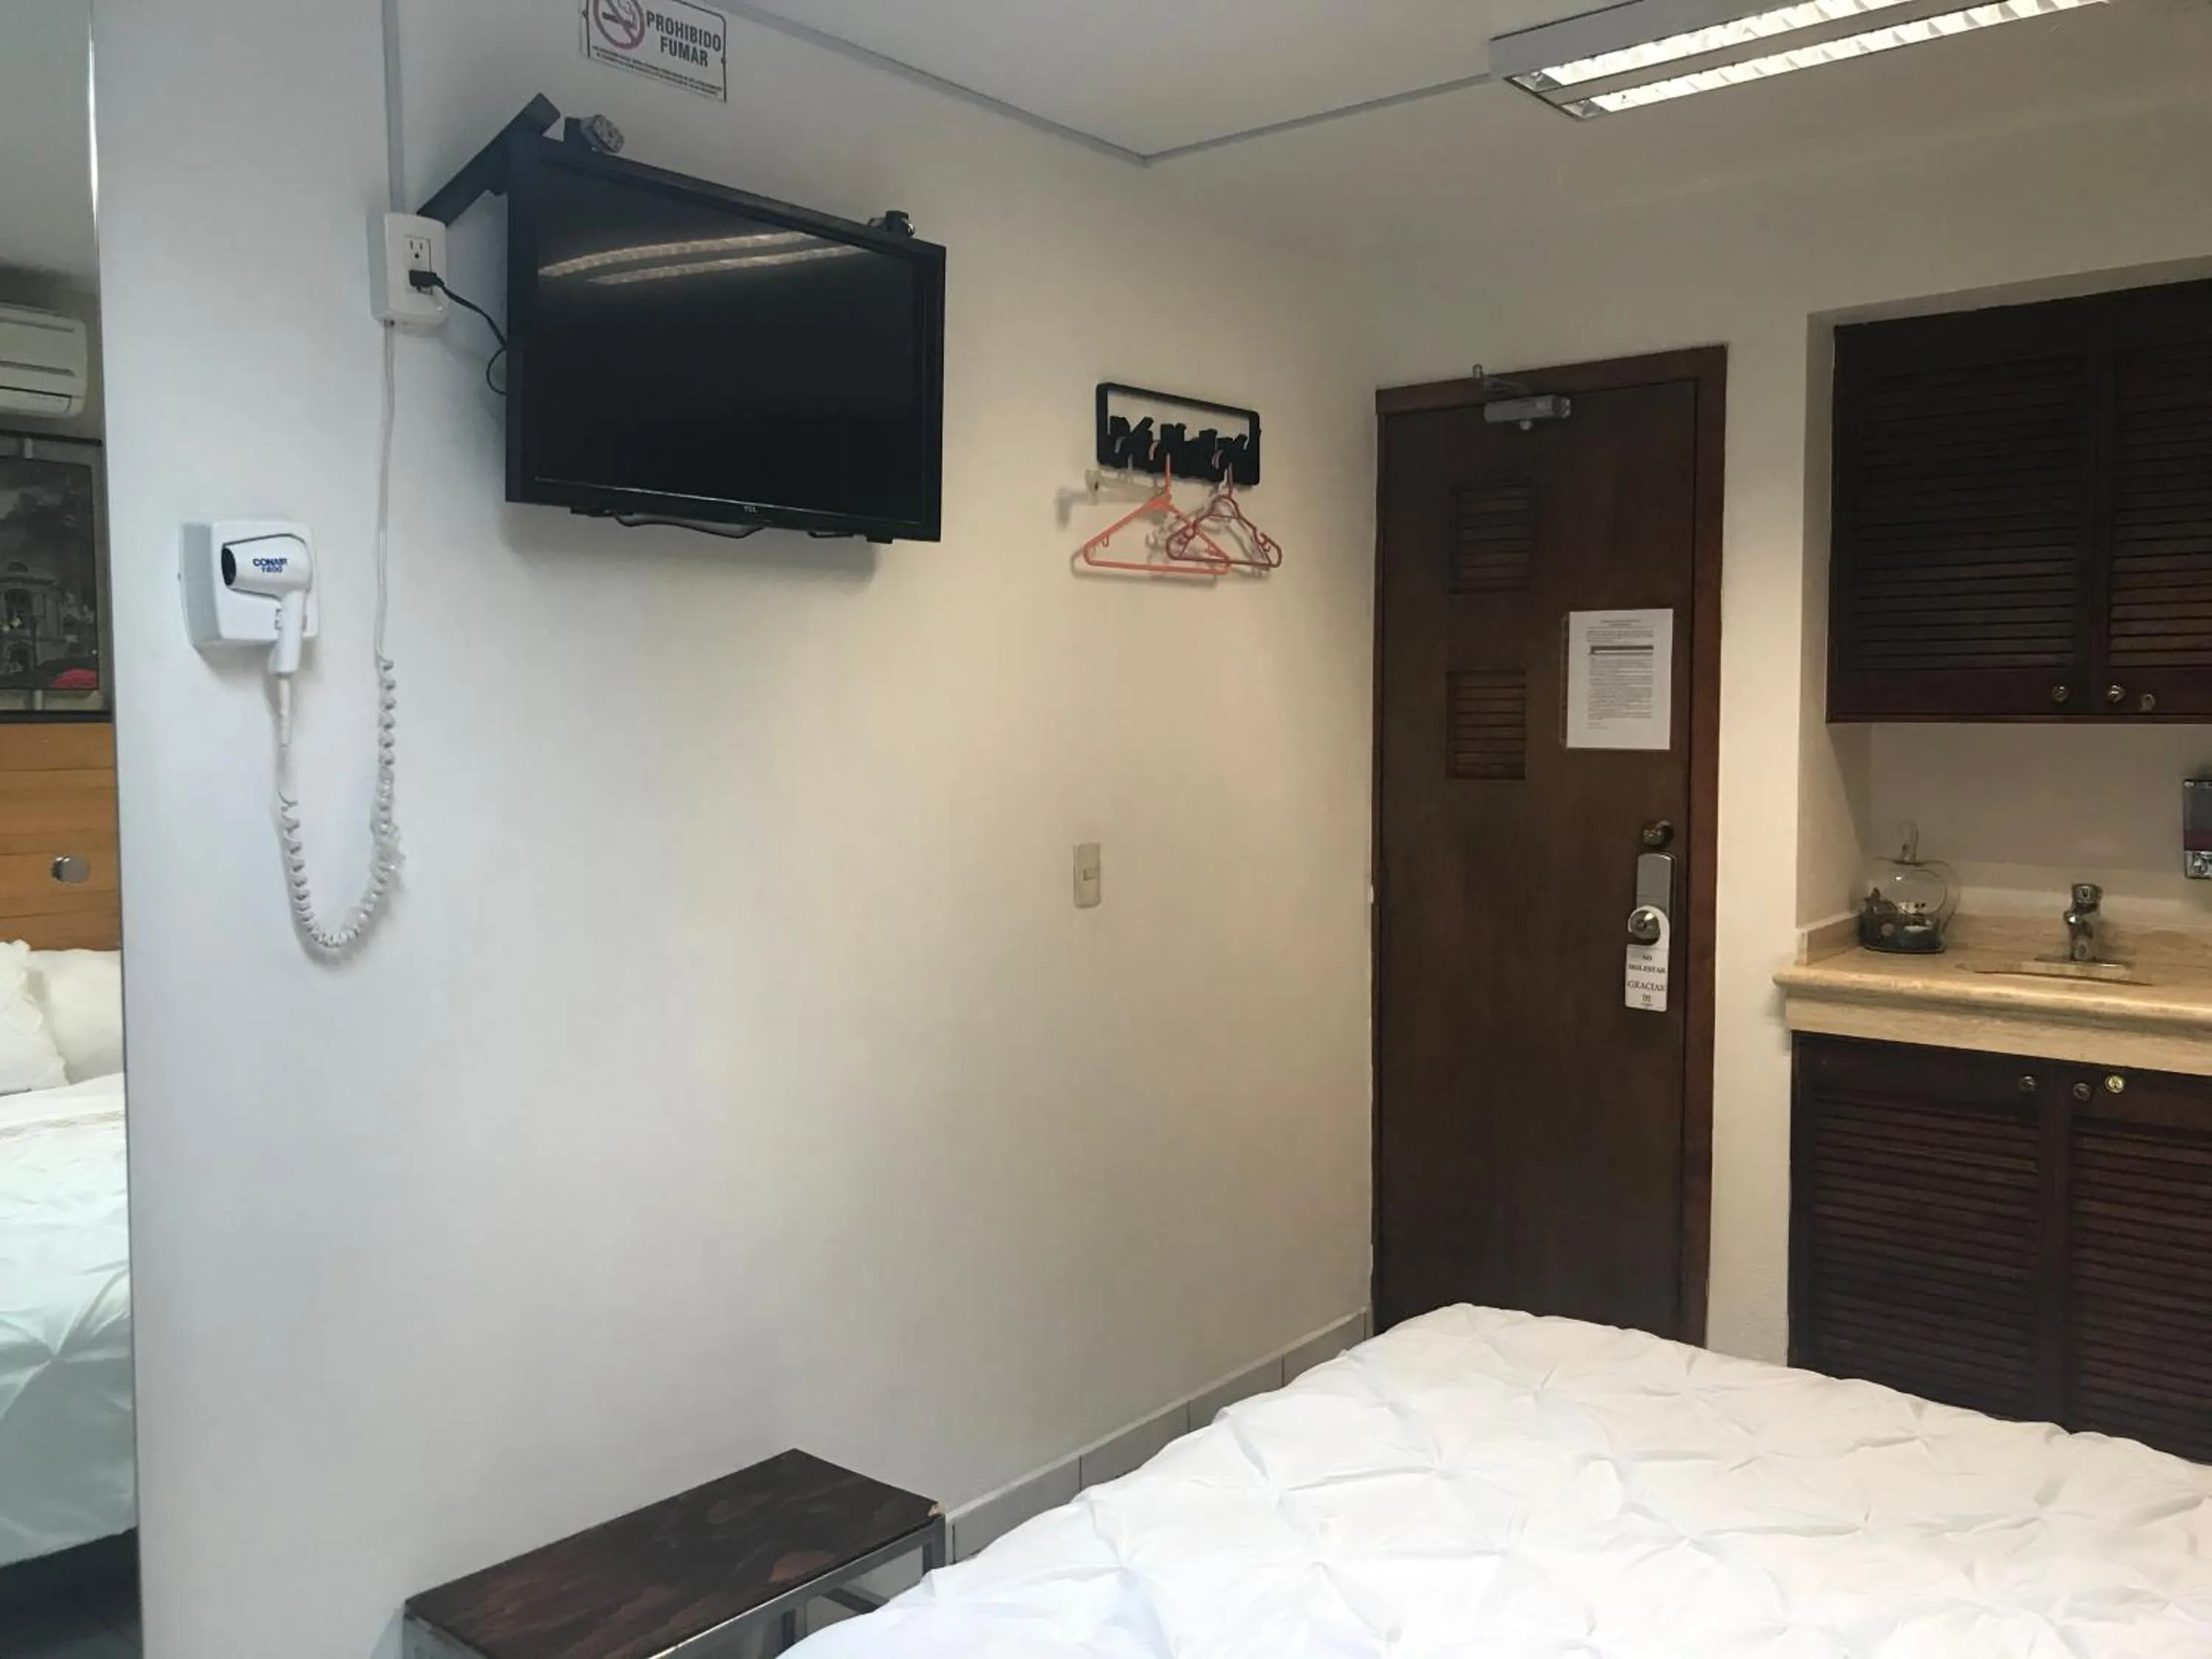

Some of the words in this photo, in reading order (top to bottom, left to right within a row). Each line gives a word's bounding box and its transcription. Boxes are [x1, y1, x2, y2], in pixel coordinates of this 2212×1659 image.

[646, 10, 721, 52] PROHIBIDO
[659, 36, 708, 66] FUMAR
[253, 557, 288, 567] CONAIR
[1627, 979, 1666, 992] GRACIAS
